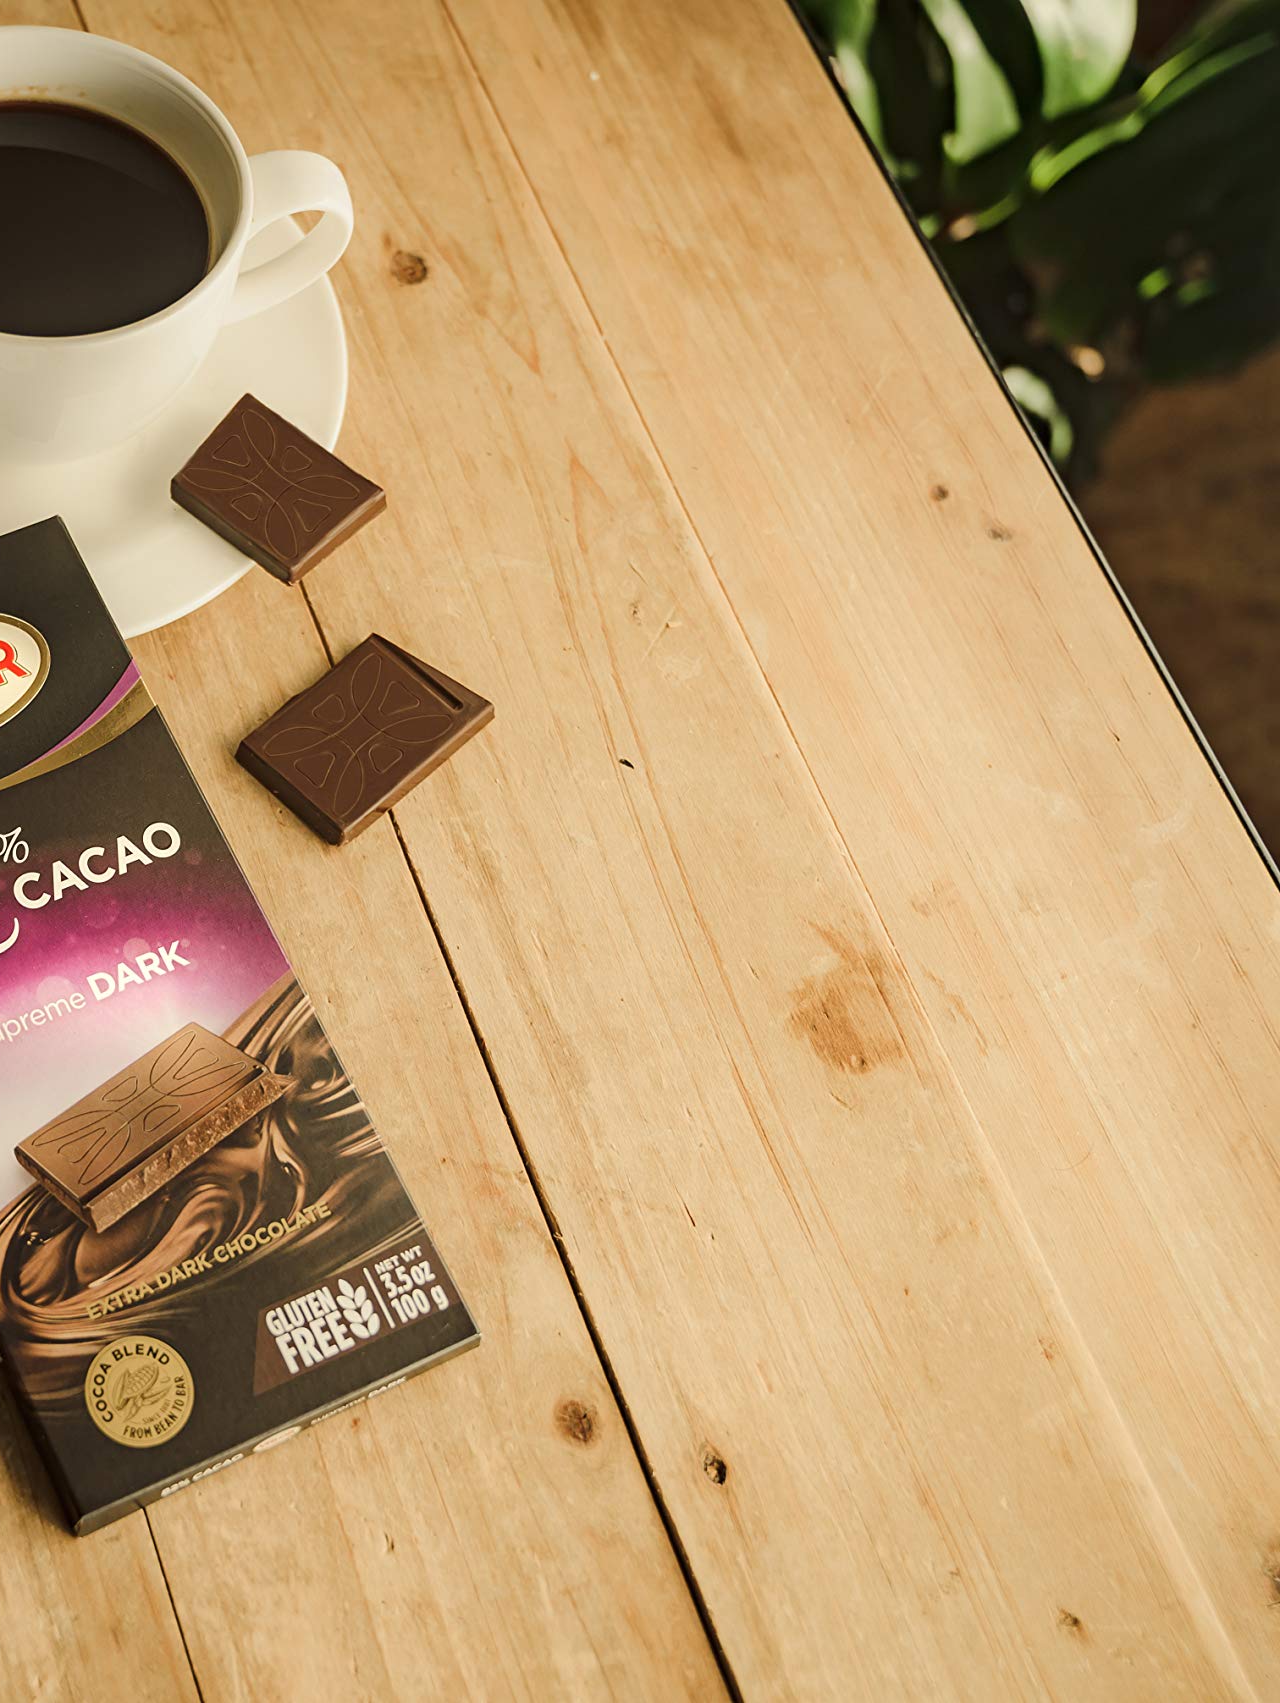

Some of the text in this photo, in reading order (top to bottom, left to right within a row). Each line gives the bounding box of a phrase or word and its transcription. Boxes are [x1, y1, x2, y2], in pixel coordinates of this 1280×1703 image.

[13, 822, 181, 909] CACAO
[86, 940, 191, 1000] DARK
[85, 1200, 333, 1321] EXTRA DARK CHOCOLATE
[374, 1244, 423, 1275] NET WT
[265, 1286, 338, 1337] GLUTEN
[390, 1284, 450, 1324] 100 g
[275, 1310, 356, 1375] FREE
[92, 1343, 170, 1423] COCOA BLEND
[171, 1398, 185, 1412] TO
[174, 1375, 187, 1397] BAR
[122, 1425, 153, 1439] FROM
[153, 1412, 179, 1436] BEAN
